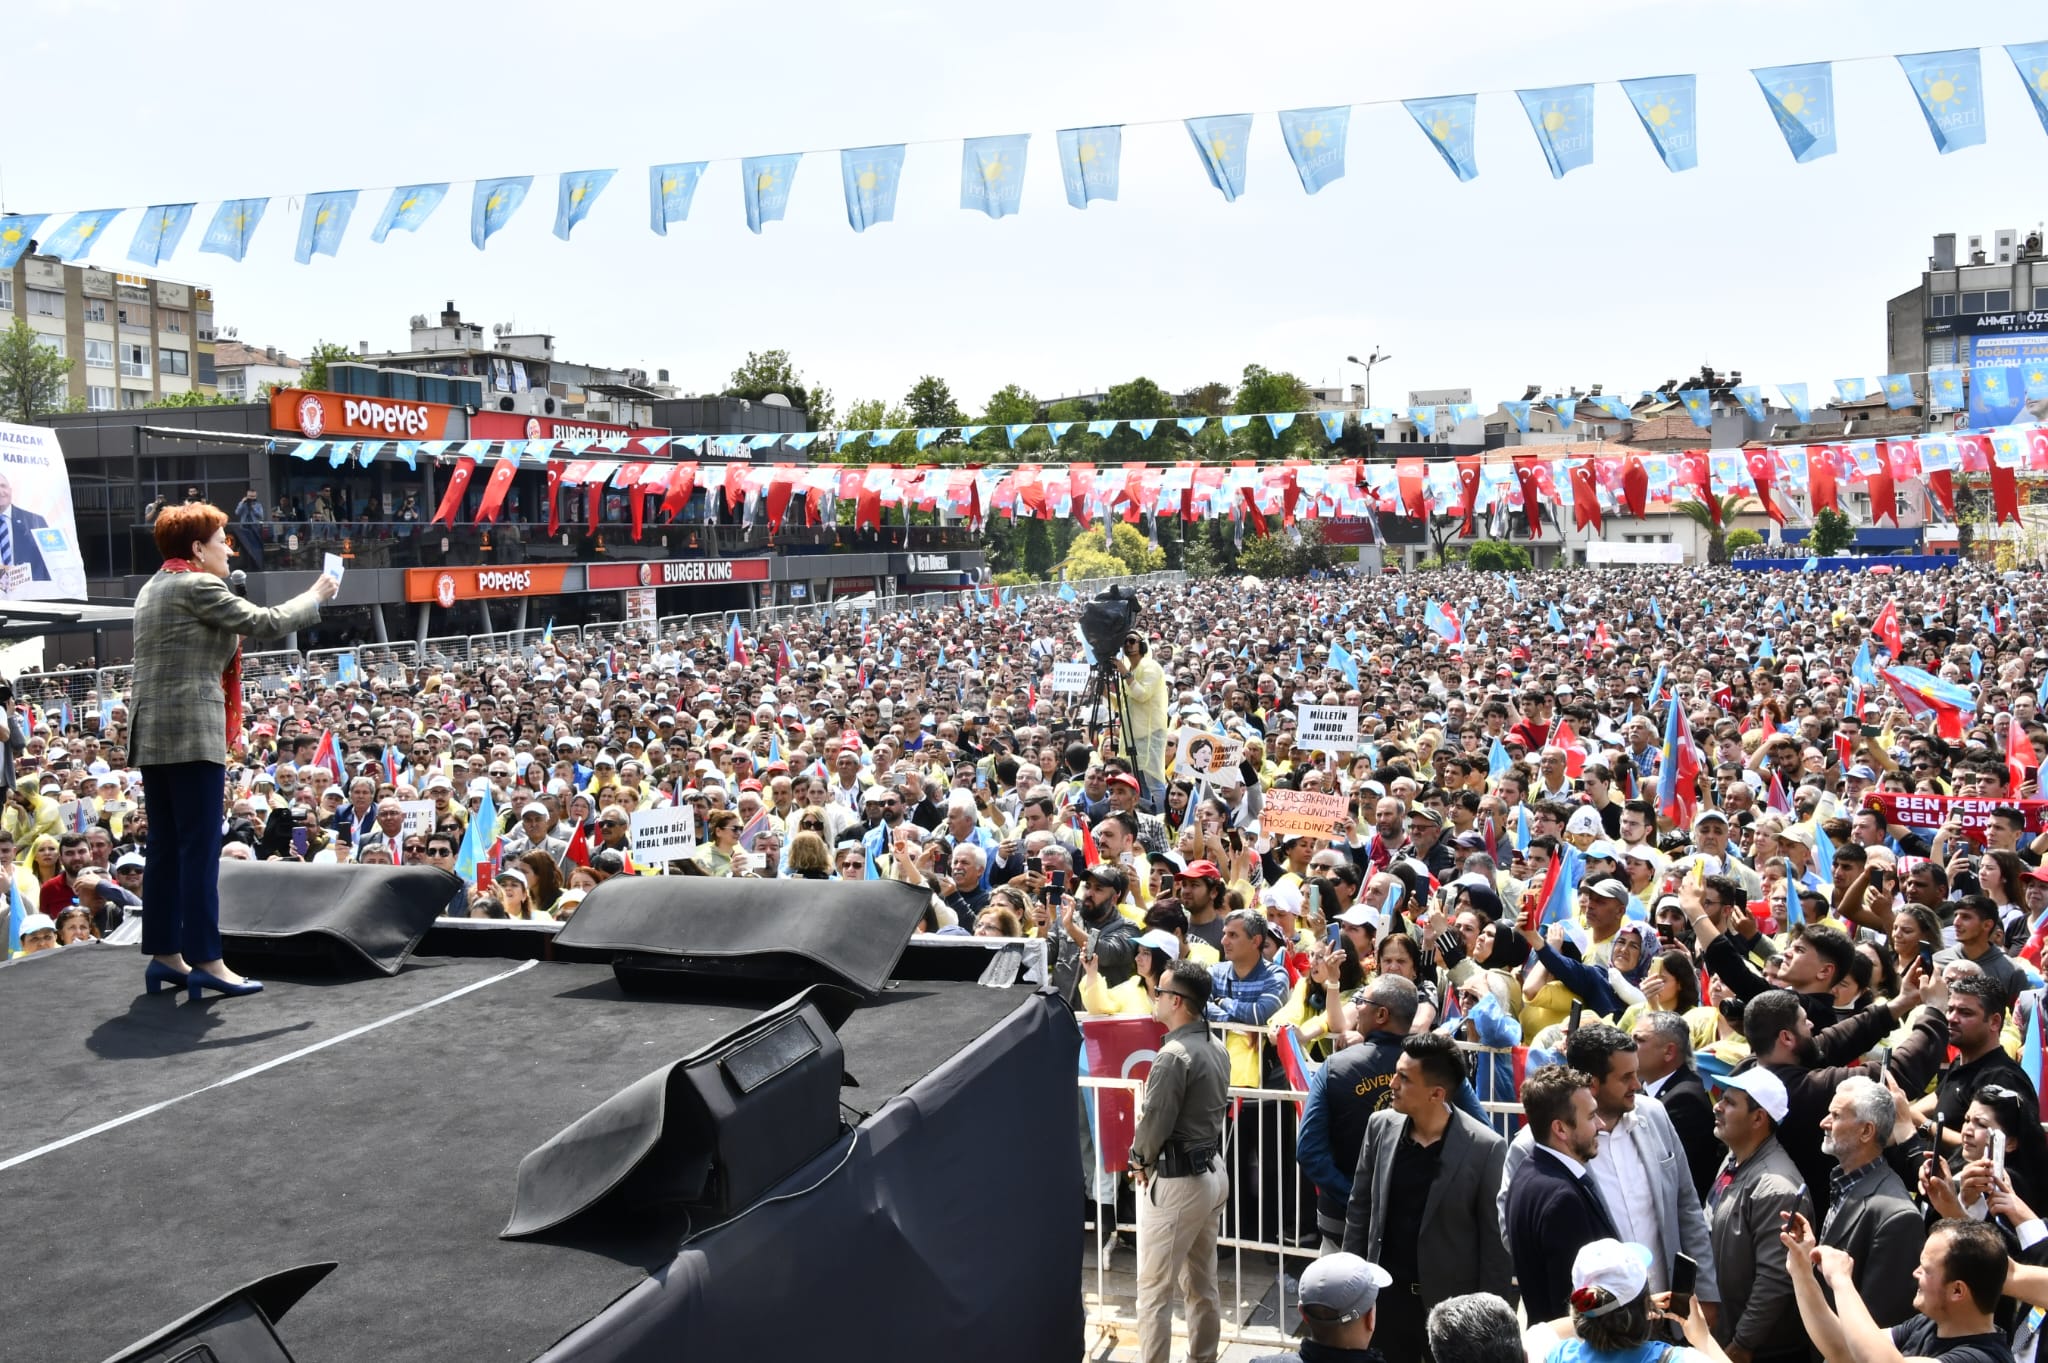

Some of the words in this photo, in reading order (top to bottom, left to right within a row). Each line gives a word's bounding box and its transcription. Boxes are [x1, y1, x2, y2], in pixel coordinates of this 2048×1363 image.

[1976, 314, 2016, 327] AHMET
[1976, 346, 2017, 358] DOĞRU
[1976, 357, 2022, 369] DOĞRU
[552, 424, 599, 446] BURGER
[3, 452, 50, 468] KARAKAŞ
[664, 562, 706, 583] BURGER
[707, 561, 732, 580] KING
[1310, 709, 1348, 721] MİLLETİN
[1313, 722, 1343, 733] UMUDU
[1302, 733, 1322, 741] MERAL
[1324, 734, 1354, 742] AKŞENER
[1895, 796, 1940, 811] BEN
[640, 825, 669, 838] KURTAR
[671, 820, 687, 833] BİZİ
[636, 838, 660, 850] MERAL
